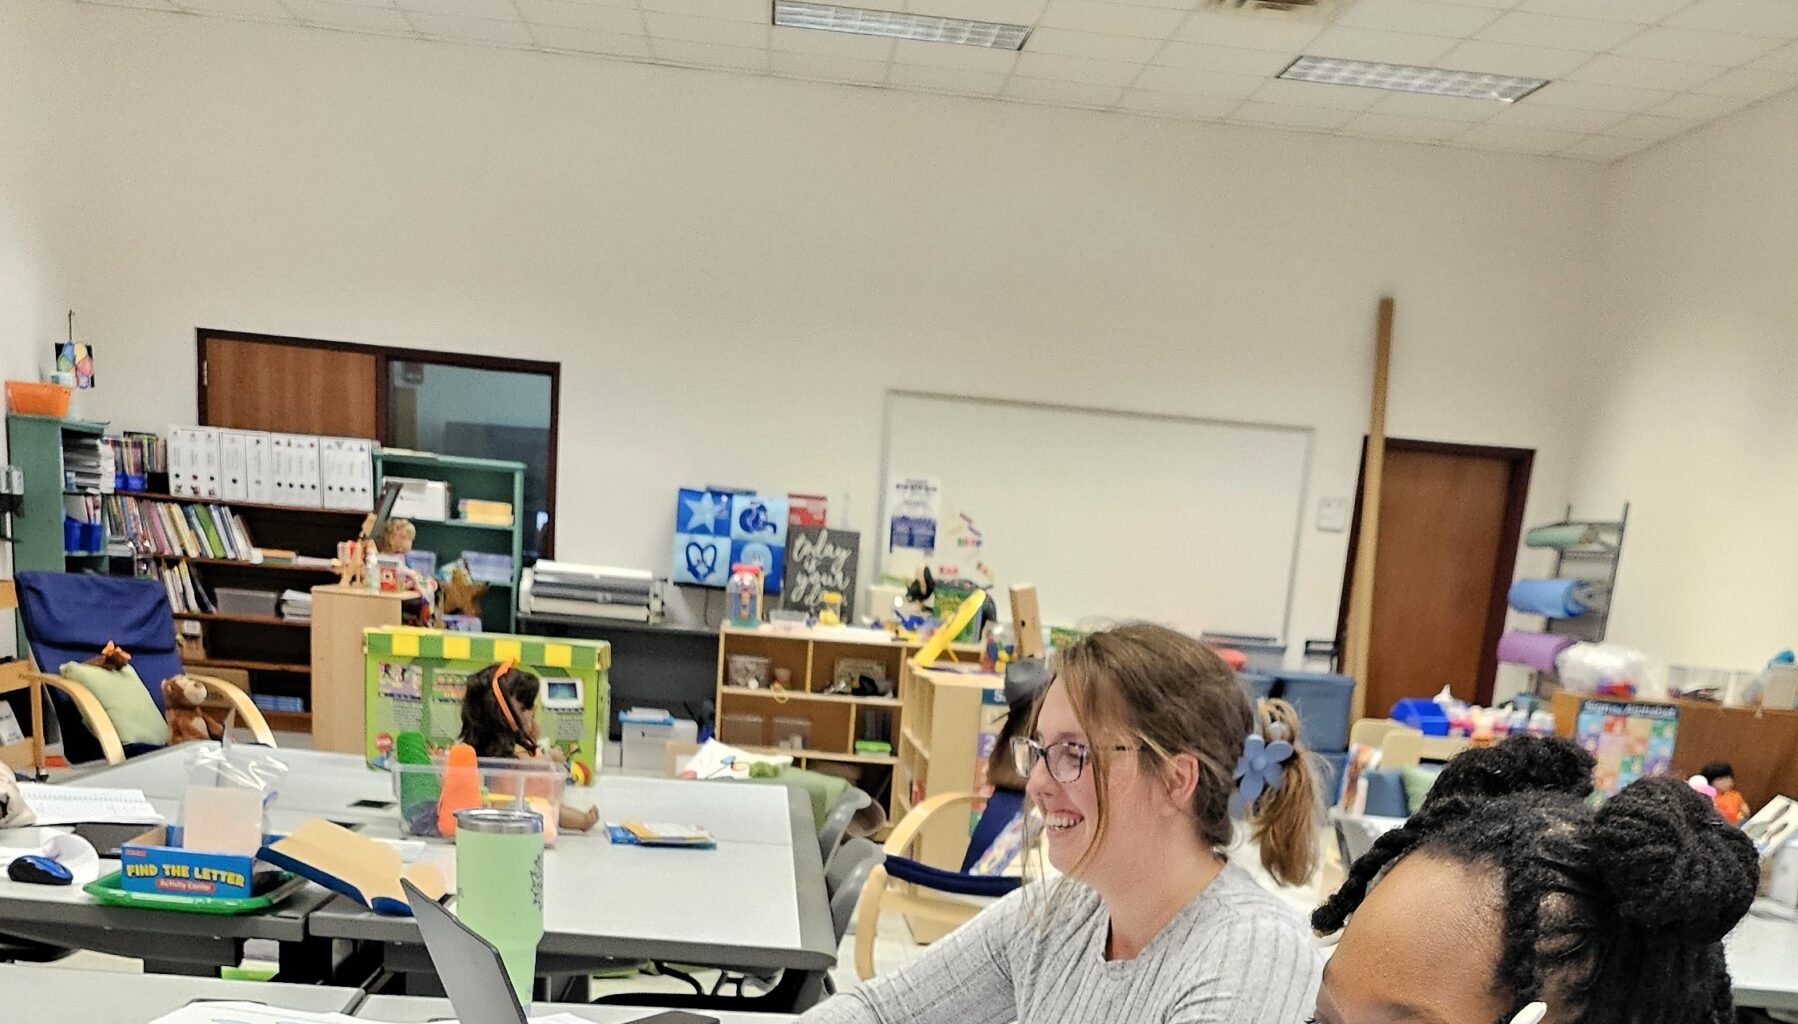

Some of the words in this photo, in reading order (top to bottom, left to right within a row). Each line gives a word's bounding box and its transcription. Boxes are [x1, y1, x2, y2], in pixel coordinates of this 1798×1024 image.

[126, 863, 158, 877] FIND
[162, 863, 190, 878] THE
[194, 866, 245, 887] LETTER
